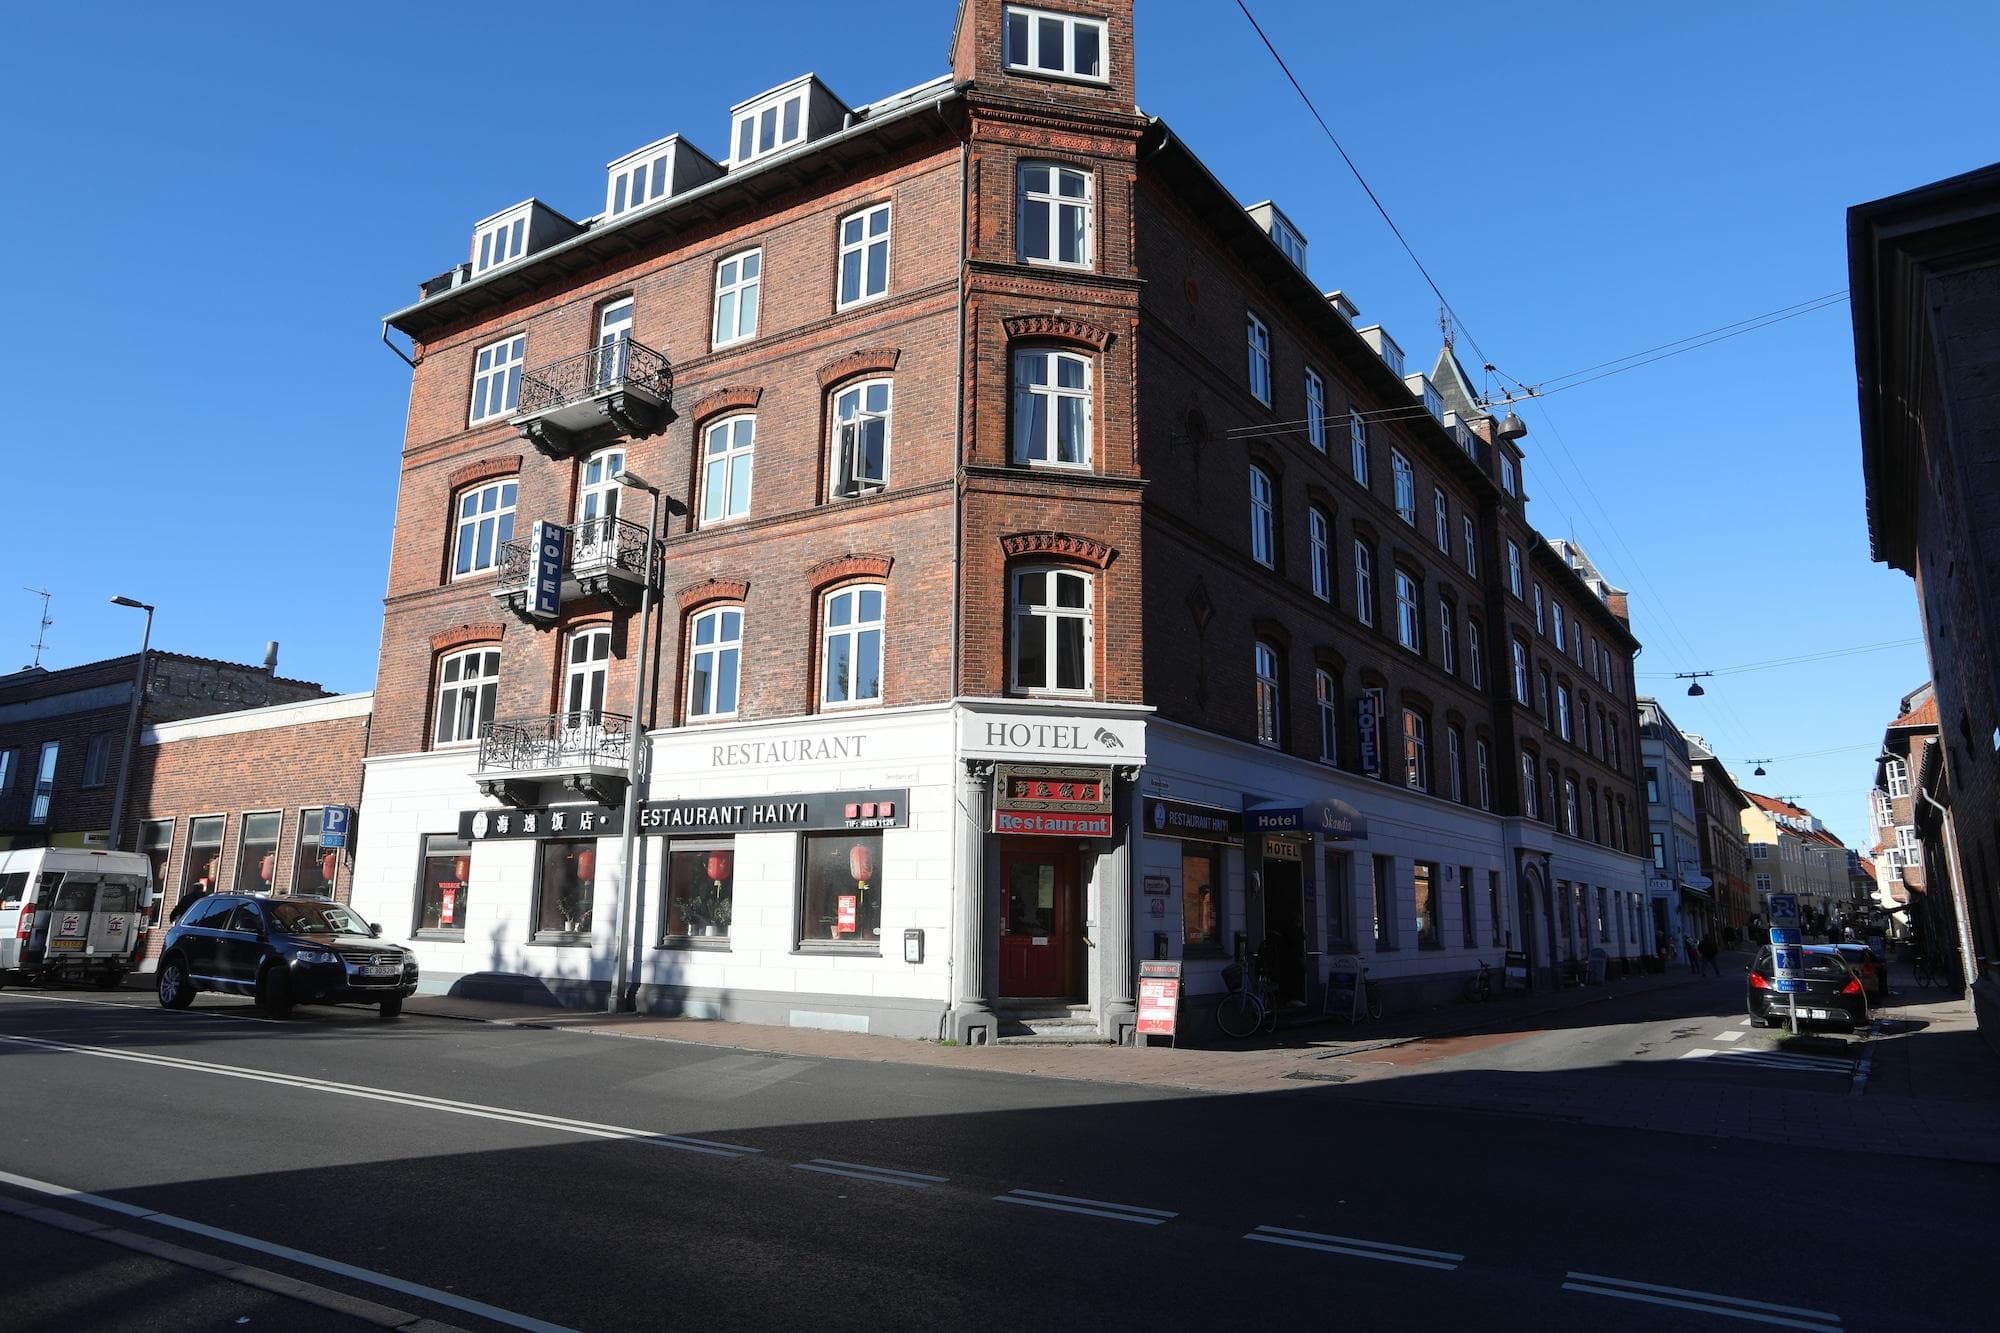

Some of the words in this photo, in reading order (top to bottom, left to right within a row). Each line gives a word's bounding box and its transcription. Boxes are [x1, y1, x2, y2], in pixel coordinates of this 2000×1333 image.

[529, 525, 540, 605] HOTEL
[542, 526, 560, 611] HOTEL
[985, 722, 1089, 750] HOTEL
[1358, 699, 1375, 770] HOTEL
[712, 735, 867, 767] RESTAURANT
[326, 809, 345, 830] P
[640, 805, 744, 827] ESTAURANT
[752, 802, 805, 823] HAIYI
[999, 814, 1107, 833] Restaurant
[1169, 811, 1211, 829] RESTAURANT
[1258, 814, 1297, 827] Hotel
[1322, 807, 1352, 832] Skandia
[1266, 842, 1298, 857] HOTEL
